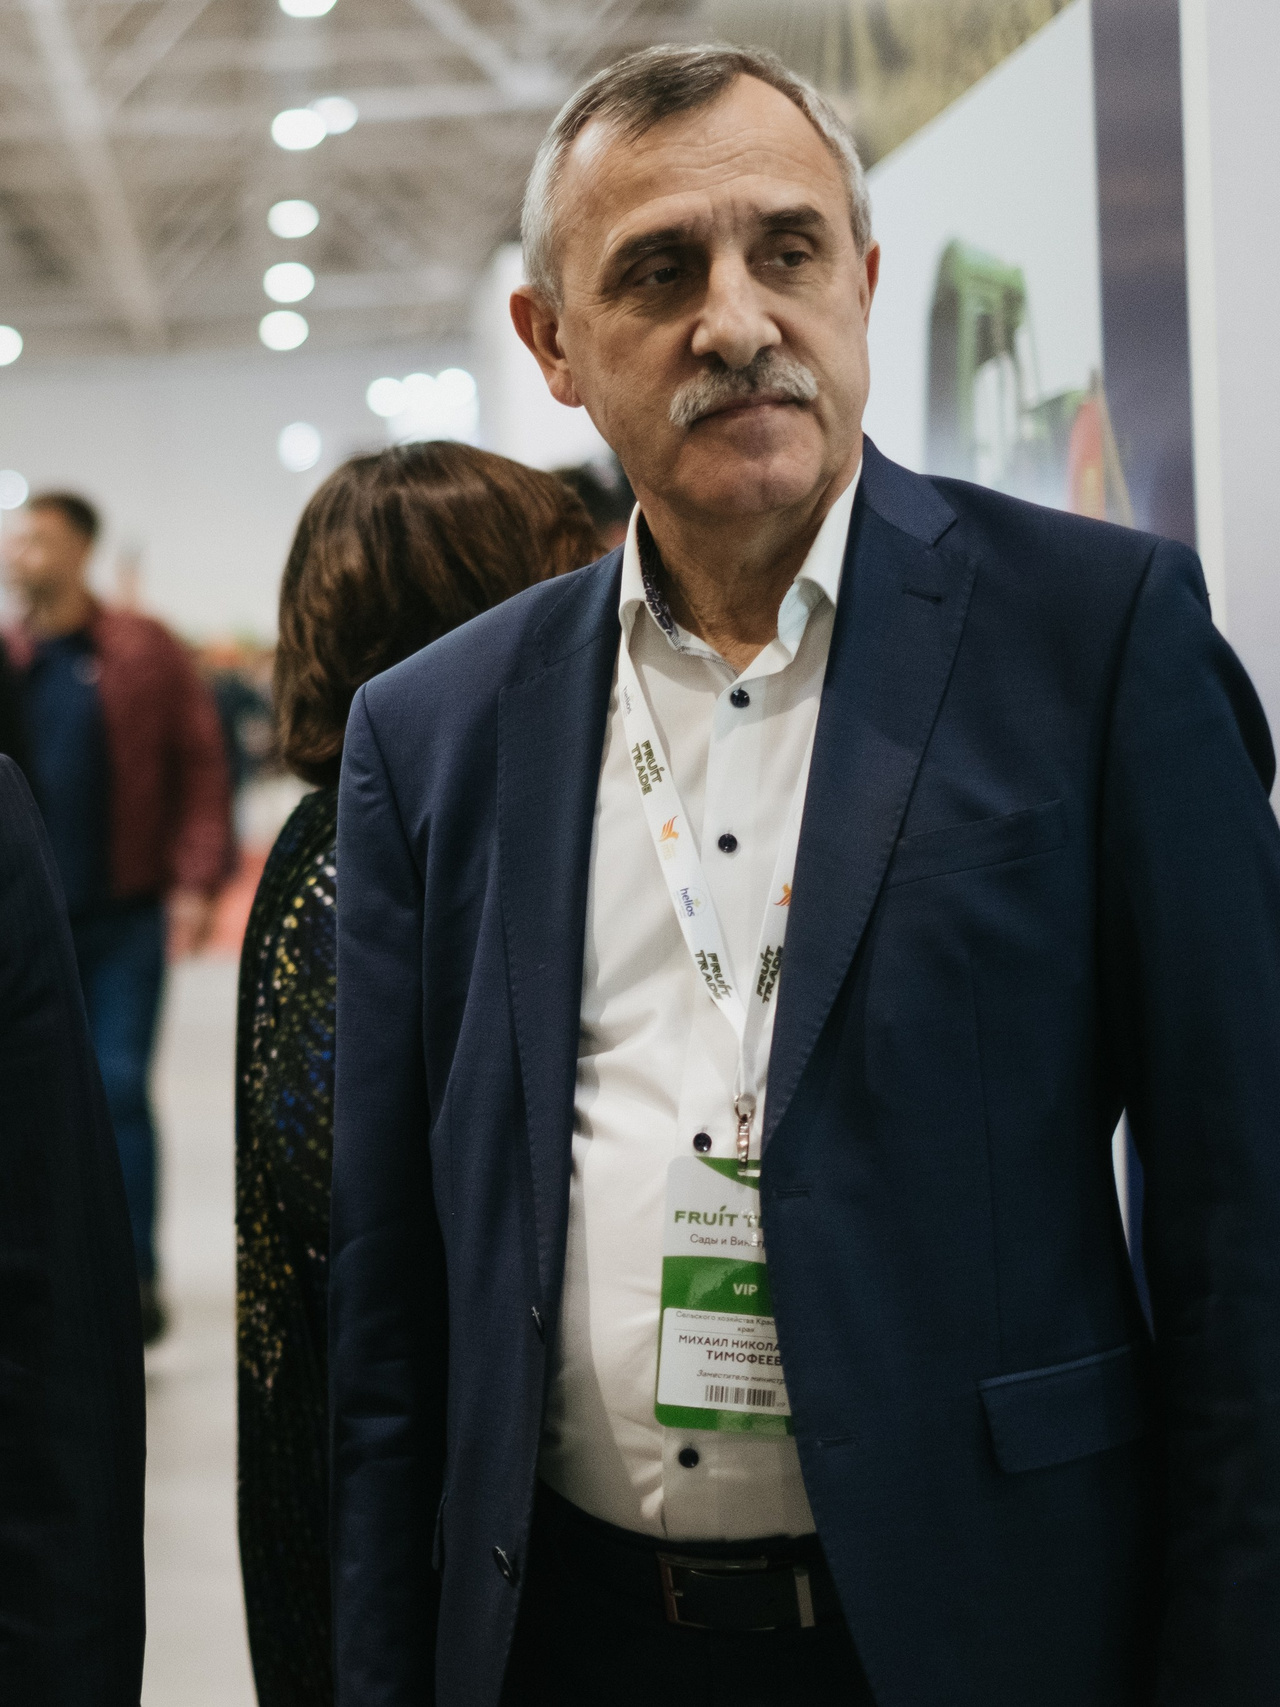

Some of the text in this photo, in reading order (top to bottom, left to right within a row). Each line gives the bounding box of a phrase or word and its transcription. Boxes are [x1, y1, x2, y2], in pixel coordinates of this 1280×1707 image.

[631, 743, 652, 795] TRADE
[641, 740, 665, 783] FRUIT
[707, 953, 732, 998] FRUIT
[756, 945, 774, 997] FRUIT
[674, 1205, 739, 1227] FRUIT
[690, 1233, 718, 1245] Сады
[733, 1283, 758, 1296] VIP
[679, 1335, 728, 1347] МИХАИЛ
